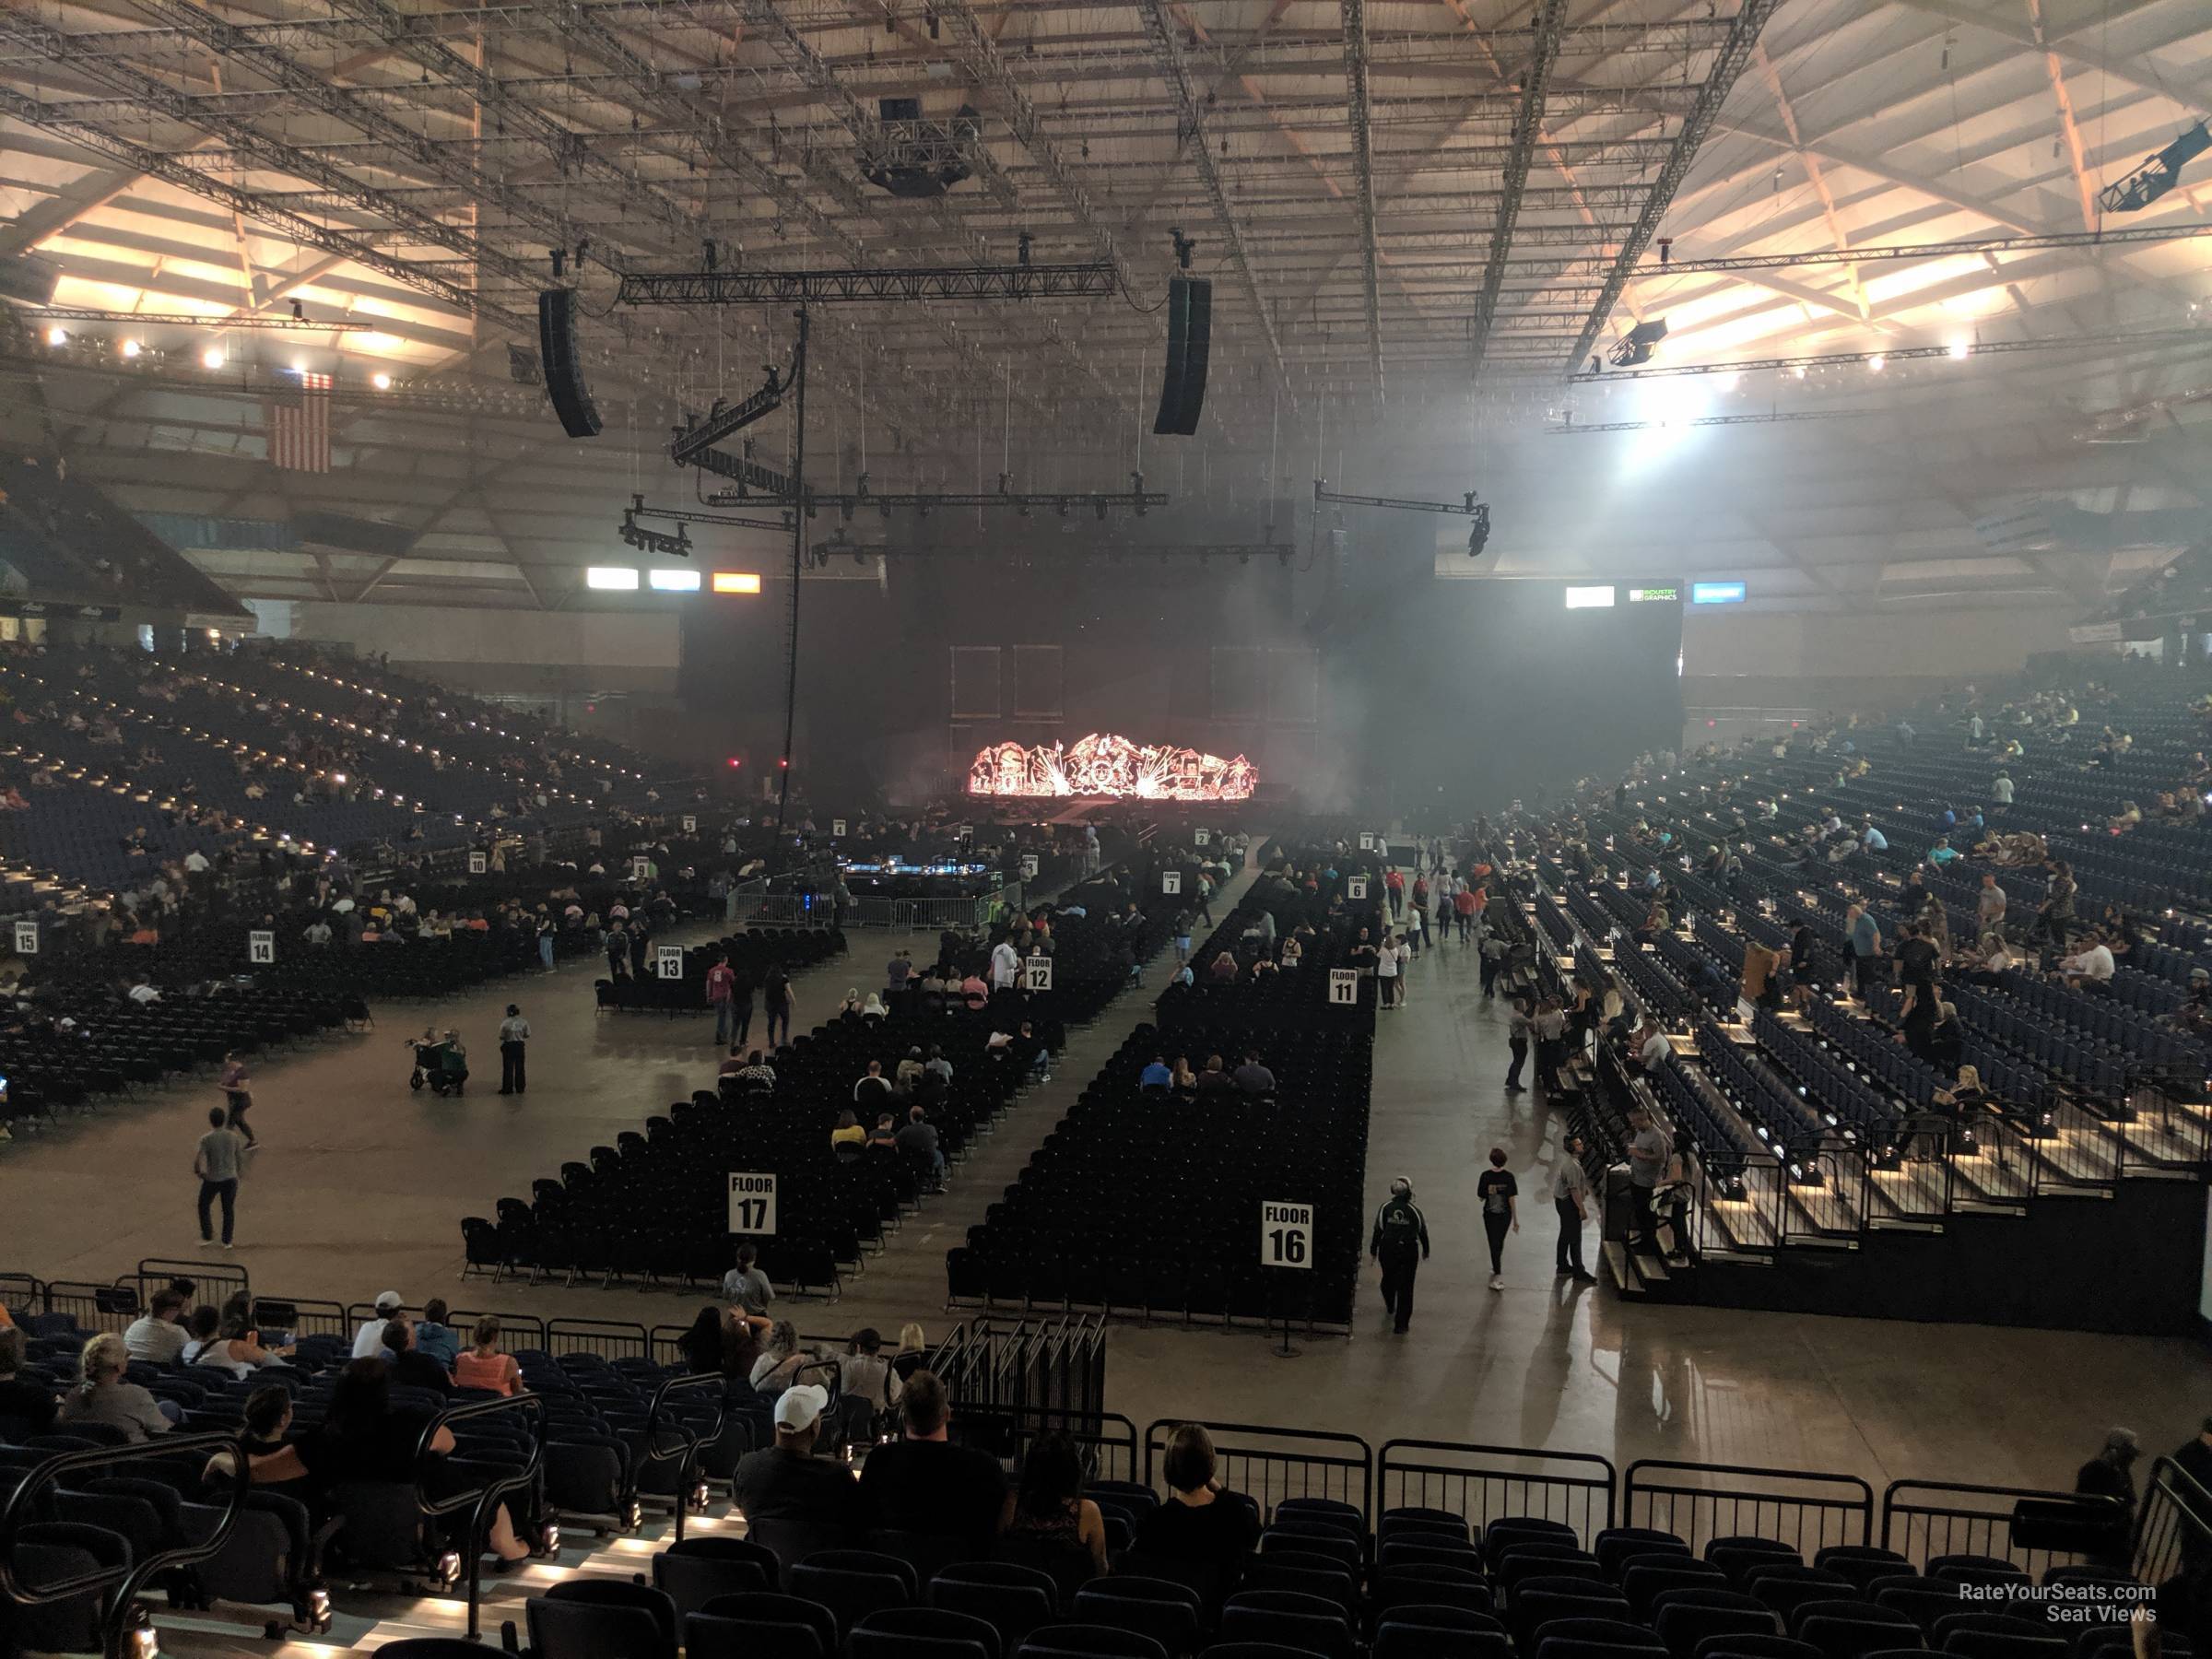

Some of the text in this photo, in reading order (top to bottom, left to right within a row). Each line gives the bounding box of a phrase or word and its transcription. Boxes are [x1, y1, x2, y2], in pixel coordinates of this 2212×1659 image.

[1199, 835, 1206, 844] 2
[472, 861, 484, 872] 10
[639, 865, 645, 877] 9
[1169, 881, 1175, 892] 7
[1354, 886, 1361, 897] 6
[19, 935, 35, 950] 15
[254, 945, 270, 960] 14
[662, 959, 678, 976] 13
[1028, 959, 1050, 967] FLOOR
[1030, 971, 1048, 987] 12
[1331, 971, 1356, 981] FLOOR
[1335, 983, 1351, 1001] 11
[732, 1177, 772, 1193] FLOOR
[737, 1198, 767, 1230] 17
[1265, 1206, 1309, 1224] FLOOR
[1269, 1230, 1305, 1263] 16
